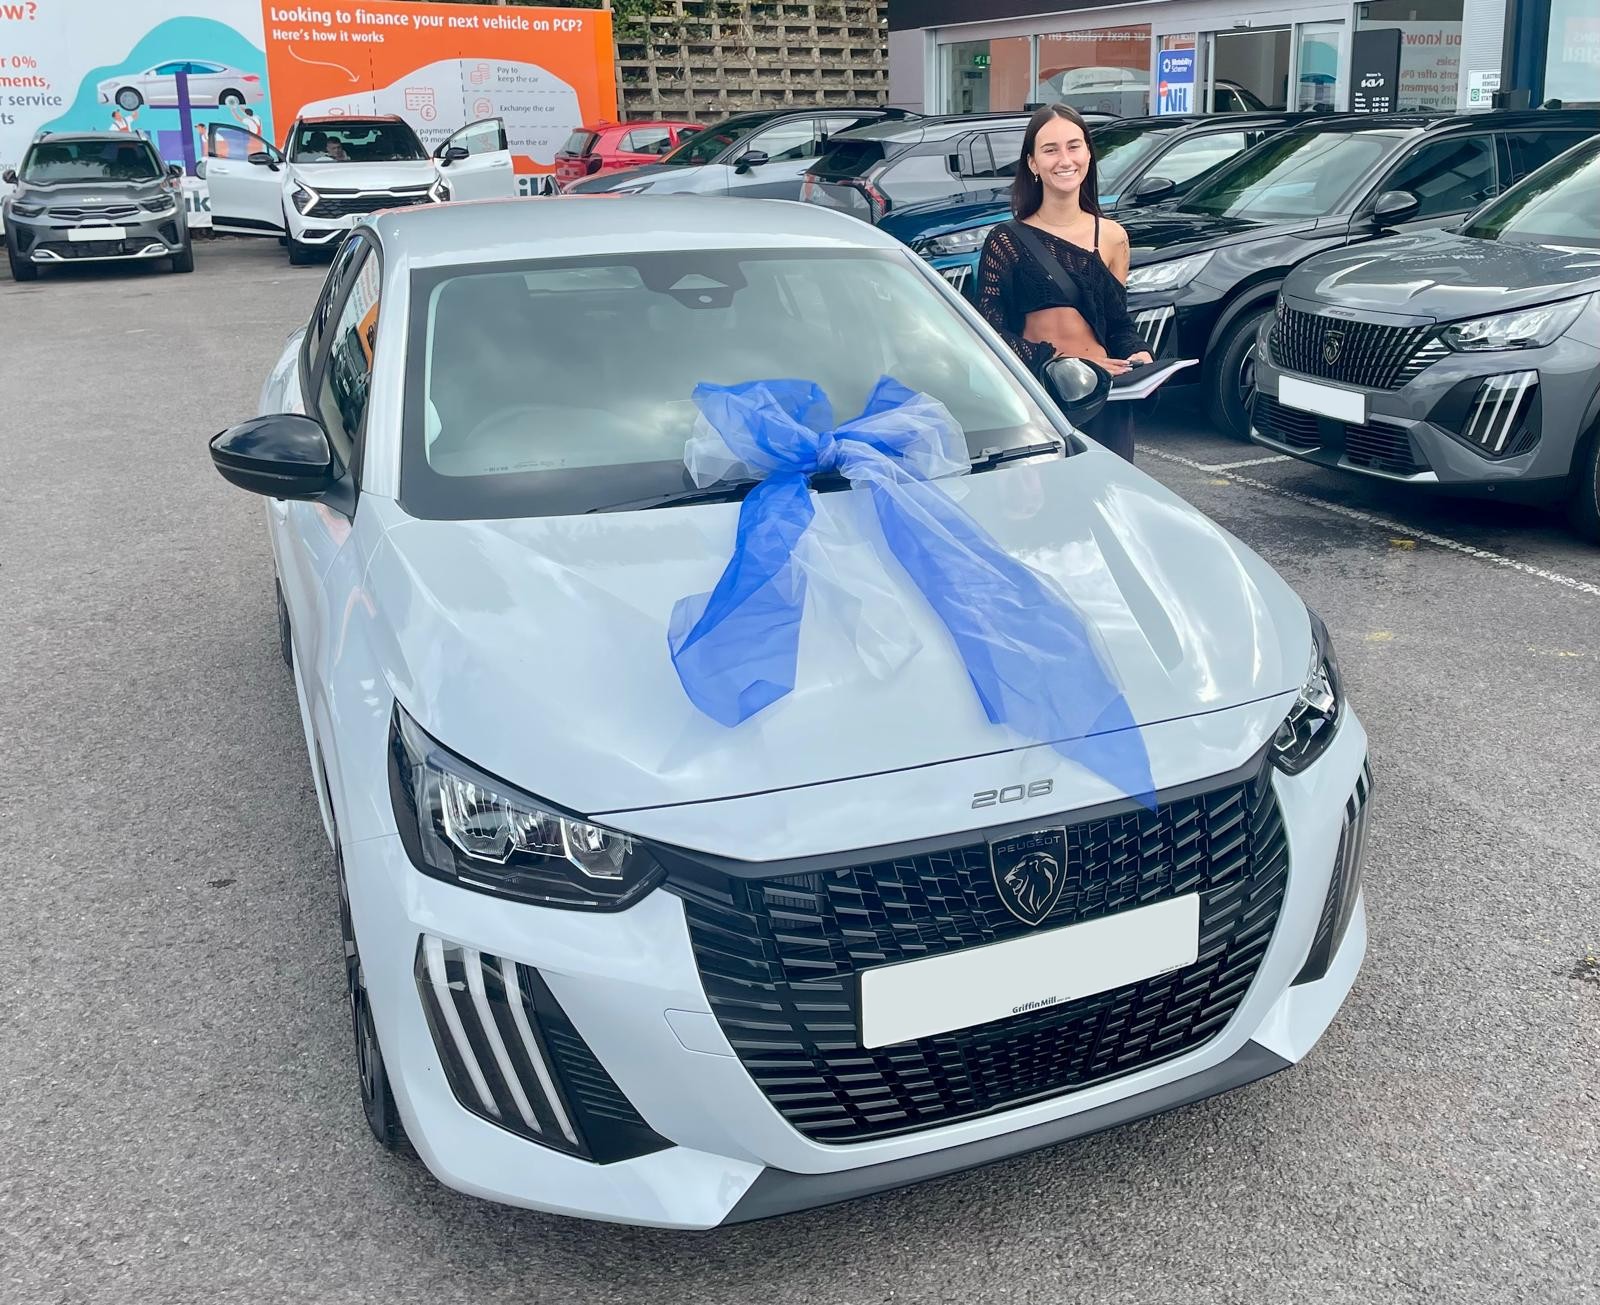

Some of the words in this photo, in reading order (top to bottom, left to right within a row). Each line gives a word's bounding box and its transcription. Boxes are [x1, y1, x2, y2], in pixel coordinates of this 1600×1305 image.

[271, 6, 331, 27] Looking
[336, 10, 351, 23] to
[355, 9, 409, 26] finance
[413, 14, 444, 29] your
[448, 15, 479, 29] next
[482, 14, 529, 30] vehicle
[533, 19, 550, 31] on
[553, 19, 583, 32] PCP?
[272, 28, 310, 41] Here's
[312, 29, 337, 42] how
[340, 30, 349, 42] it
[351, 31, 385, 43] works
[11, 56, 37, 68] 0%
[497, 66, 509, 74] Pay
[497, 75, 515, 83] keep
[8, 93, 62, 106] service
[1165, 88, 1188, 112] Nil
[500, 104, 531, 113] Exchange
[532, 104, 543, 112] the
[971, 778, 1054, 810] 208
[997, 835, 1062, 855] PEUGEOT
